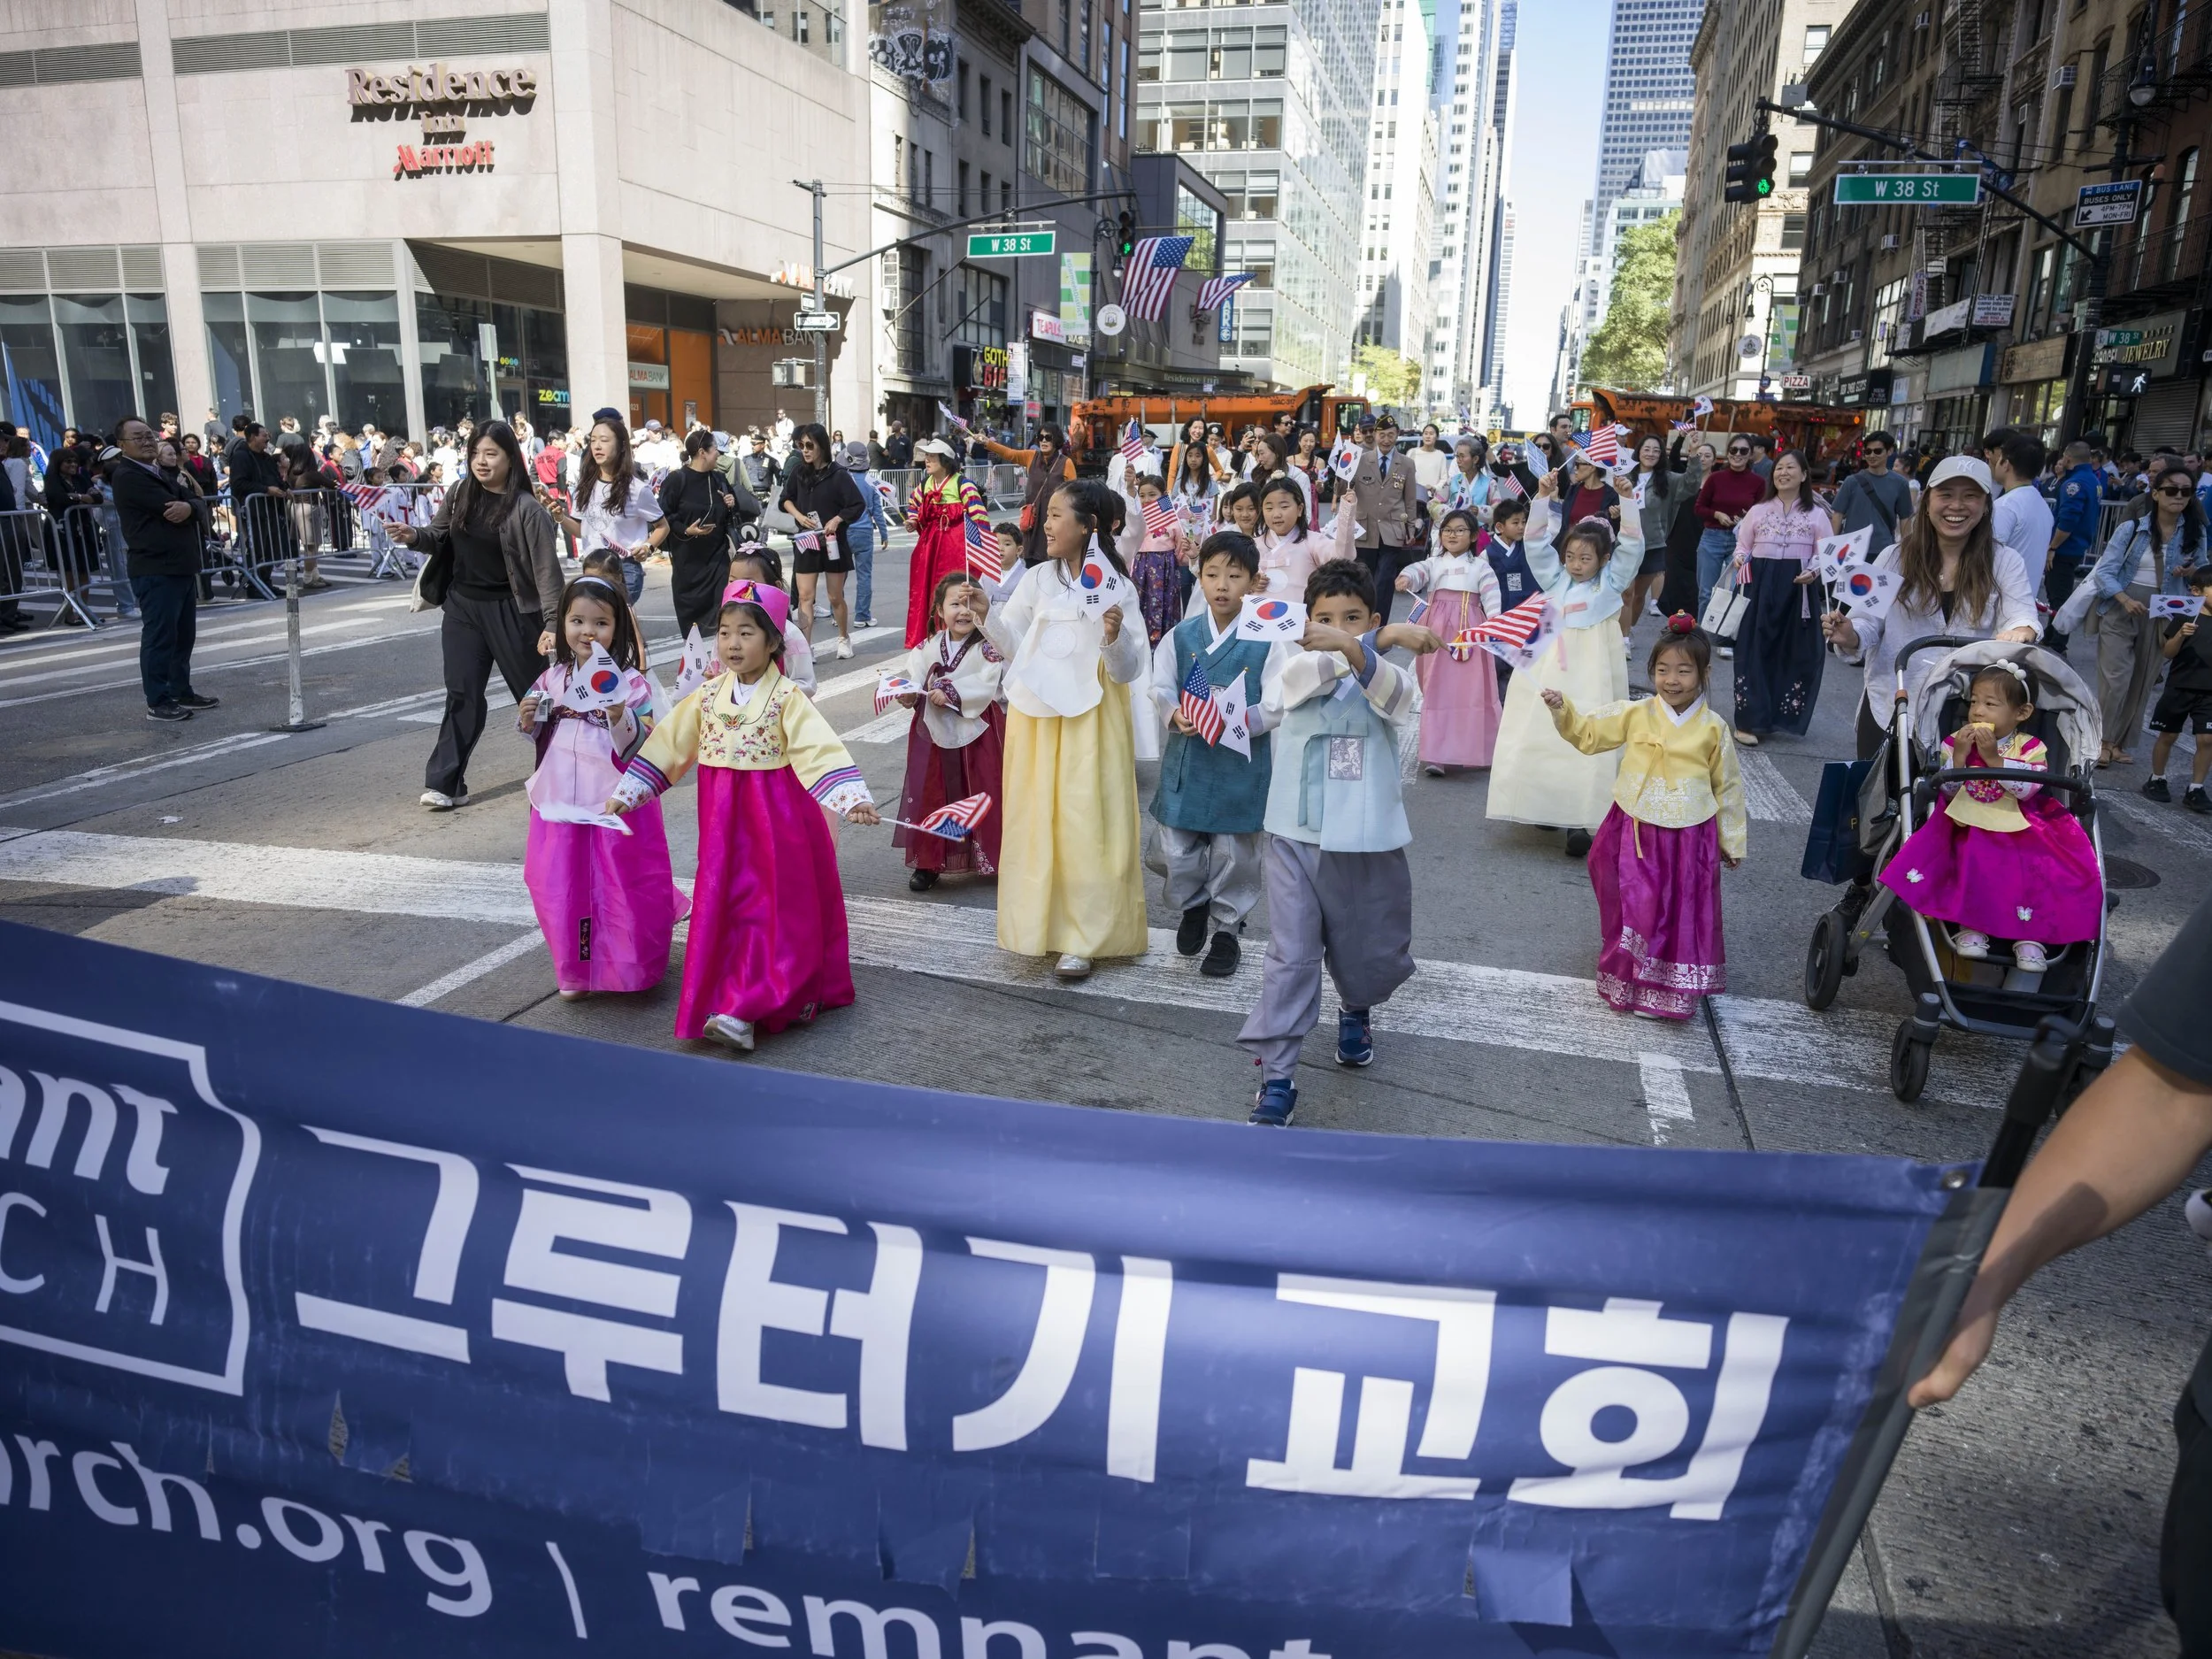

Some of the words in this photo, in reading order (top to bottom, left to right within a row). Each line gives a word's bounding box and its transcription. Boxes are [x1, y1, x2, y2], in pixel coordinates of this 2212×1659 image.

[345, 63, 536, 105] Residence
[419, 111, 466, 133] Inn
[393, 140, 494, 173] Marriott
[1875, 180, 1888, 197] W
[1893, 180, 1915, 197] 38
[1922, 180, 1939, 197] St
[2115, 182, 2135, 191] LANE
[2084, 196, 2109, 204] BUSES
[2111, 193, 2132, 202] ONLY
[2101, 204, 2132, 212] 4PM-7PM
[2102, 211, 2131, 220] MON-FRI
[991, 239, 1000, 252] W
[1002, 238, 1017, 252] 38
[1019, 237, 1032, 251] St
[1221, 299, 1231, 327] ARK
[735, 328, 828, 346] ALMABAN
[2109, 332, 2116, 343] W
[2119, 332, 2131, 344] 38
[984, 346, 1008, 368] GOTH
[2122, 339, 2170, 364] JEWELRY
[983, 365, 1007, 389] GIF
[1164, 373, 1201, 384] Residence
[1783, 376, 1809, 387] PIZZA
[0, 1434, 492, 1617] rch.org
[648, 1571, 1334, 1659] remn
